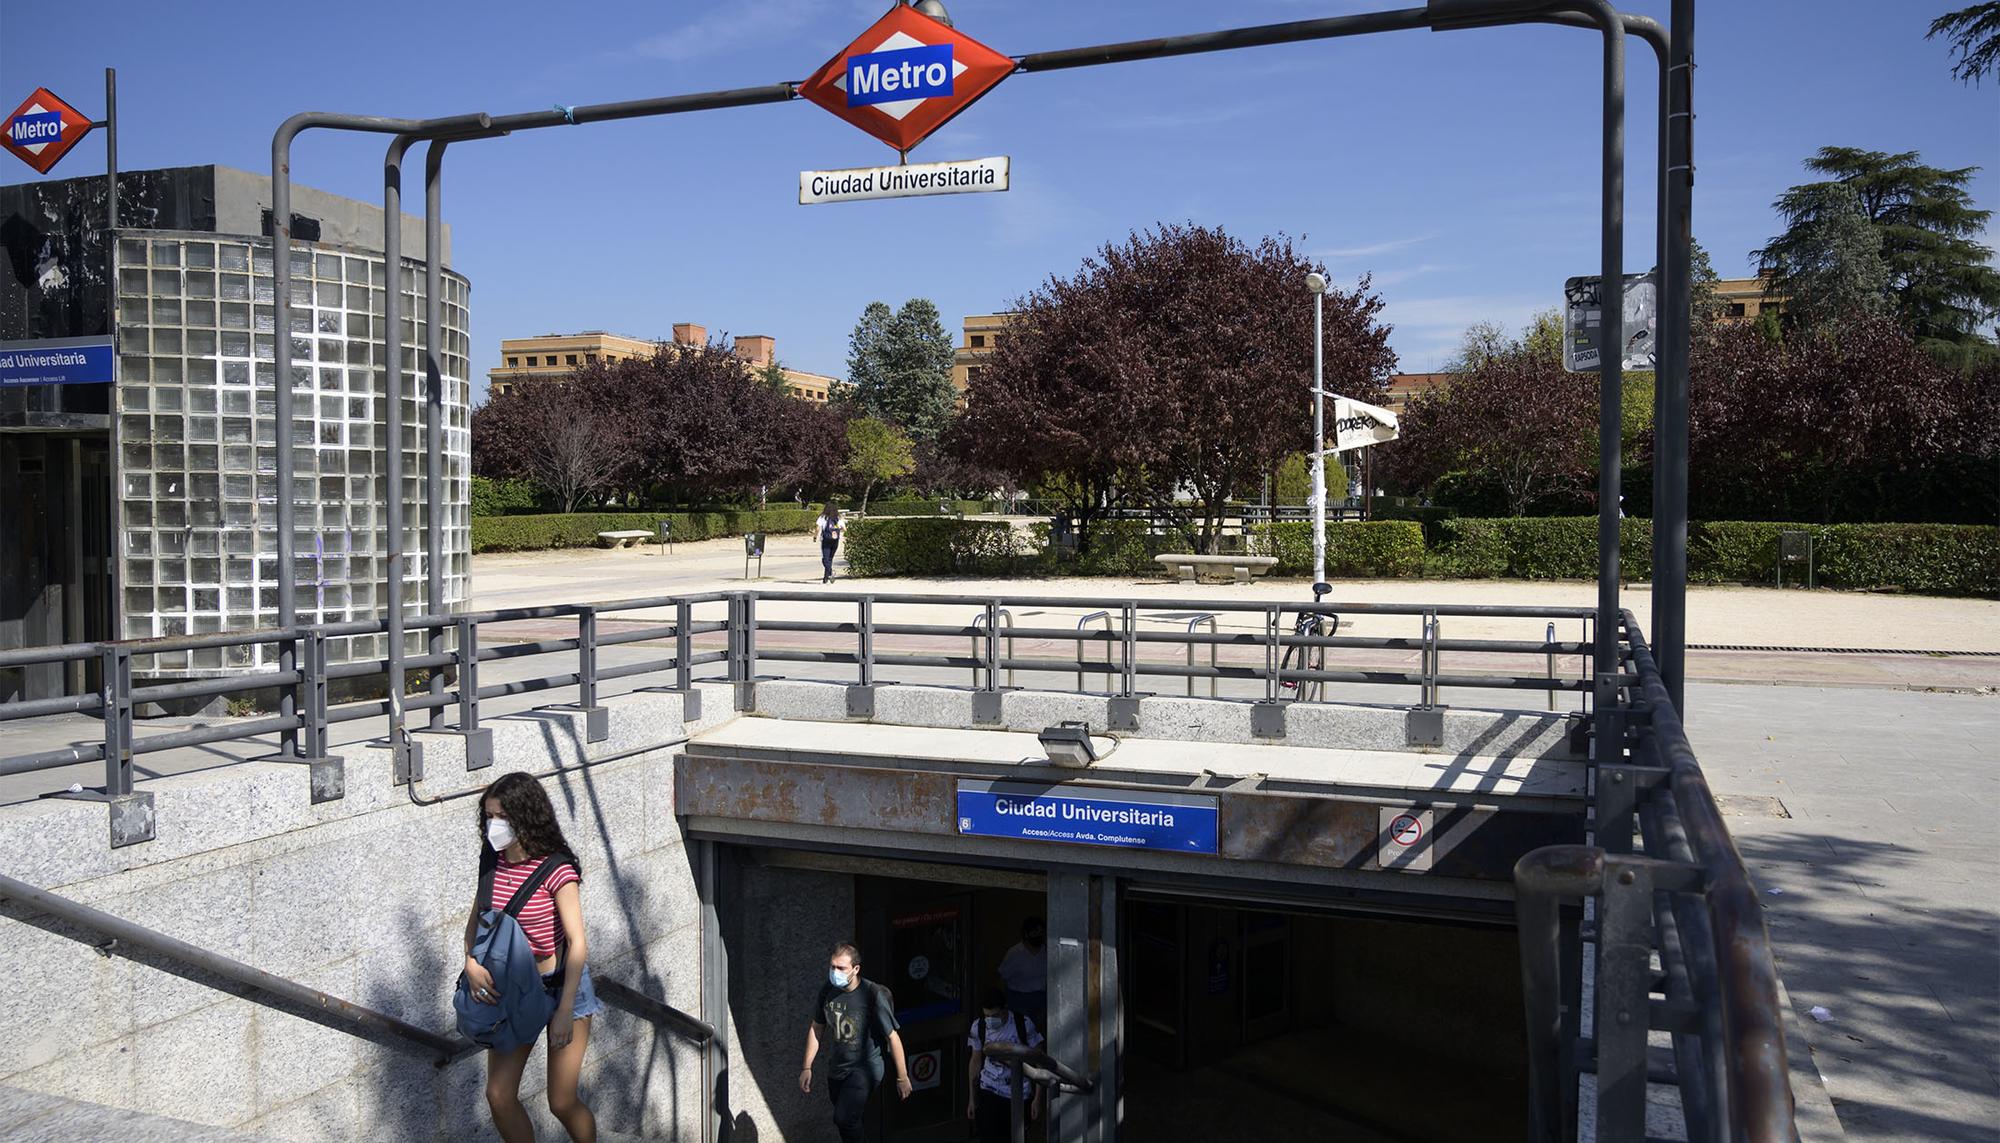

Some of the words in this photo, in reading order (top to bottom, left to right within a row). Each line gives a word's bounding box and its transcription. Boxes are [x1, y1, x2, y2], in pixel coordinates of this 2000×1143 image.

[853, 61, 947, 95] Metro
[14, 117, 58, 141] Metro
[811, 172, 873, 196] Ciudad
[879, 165, 995, 191] Universitaria
[16, 352, 87, 368] Universitaria
[961, 818, 969, 829] 6
[995, 798, 1057, 819] Ciudad
[1062, 803, 1174, 828] Universitaria
[1075, 831, 1096, 841] Avda.
[1097, 833, 1146, 845] Complutense
